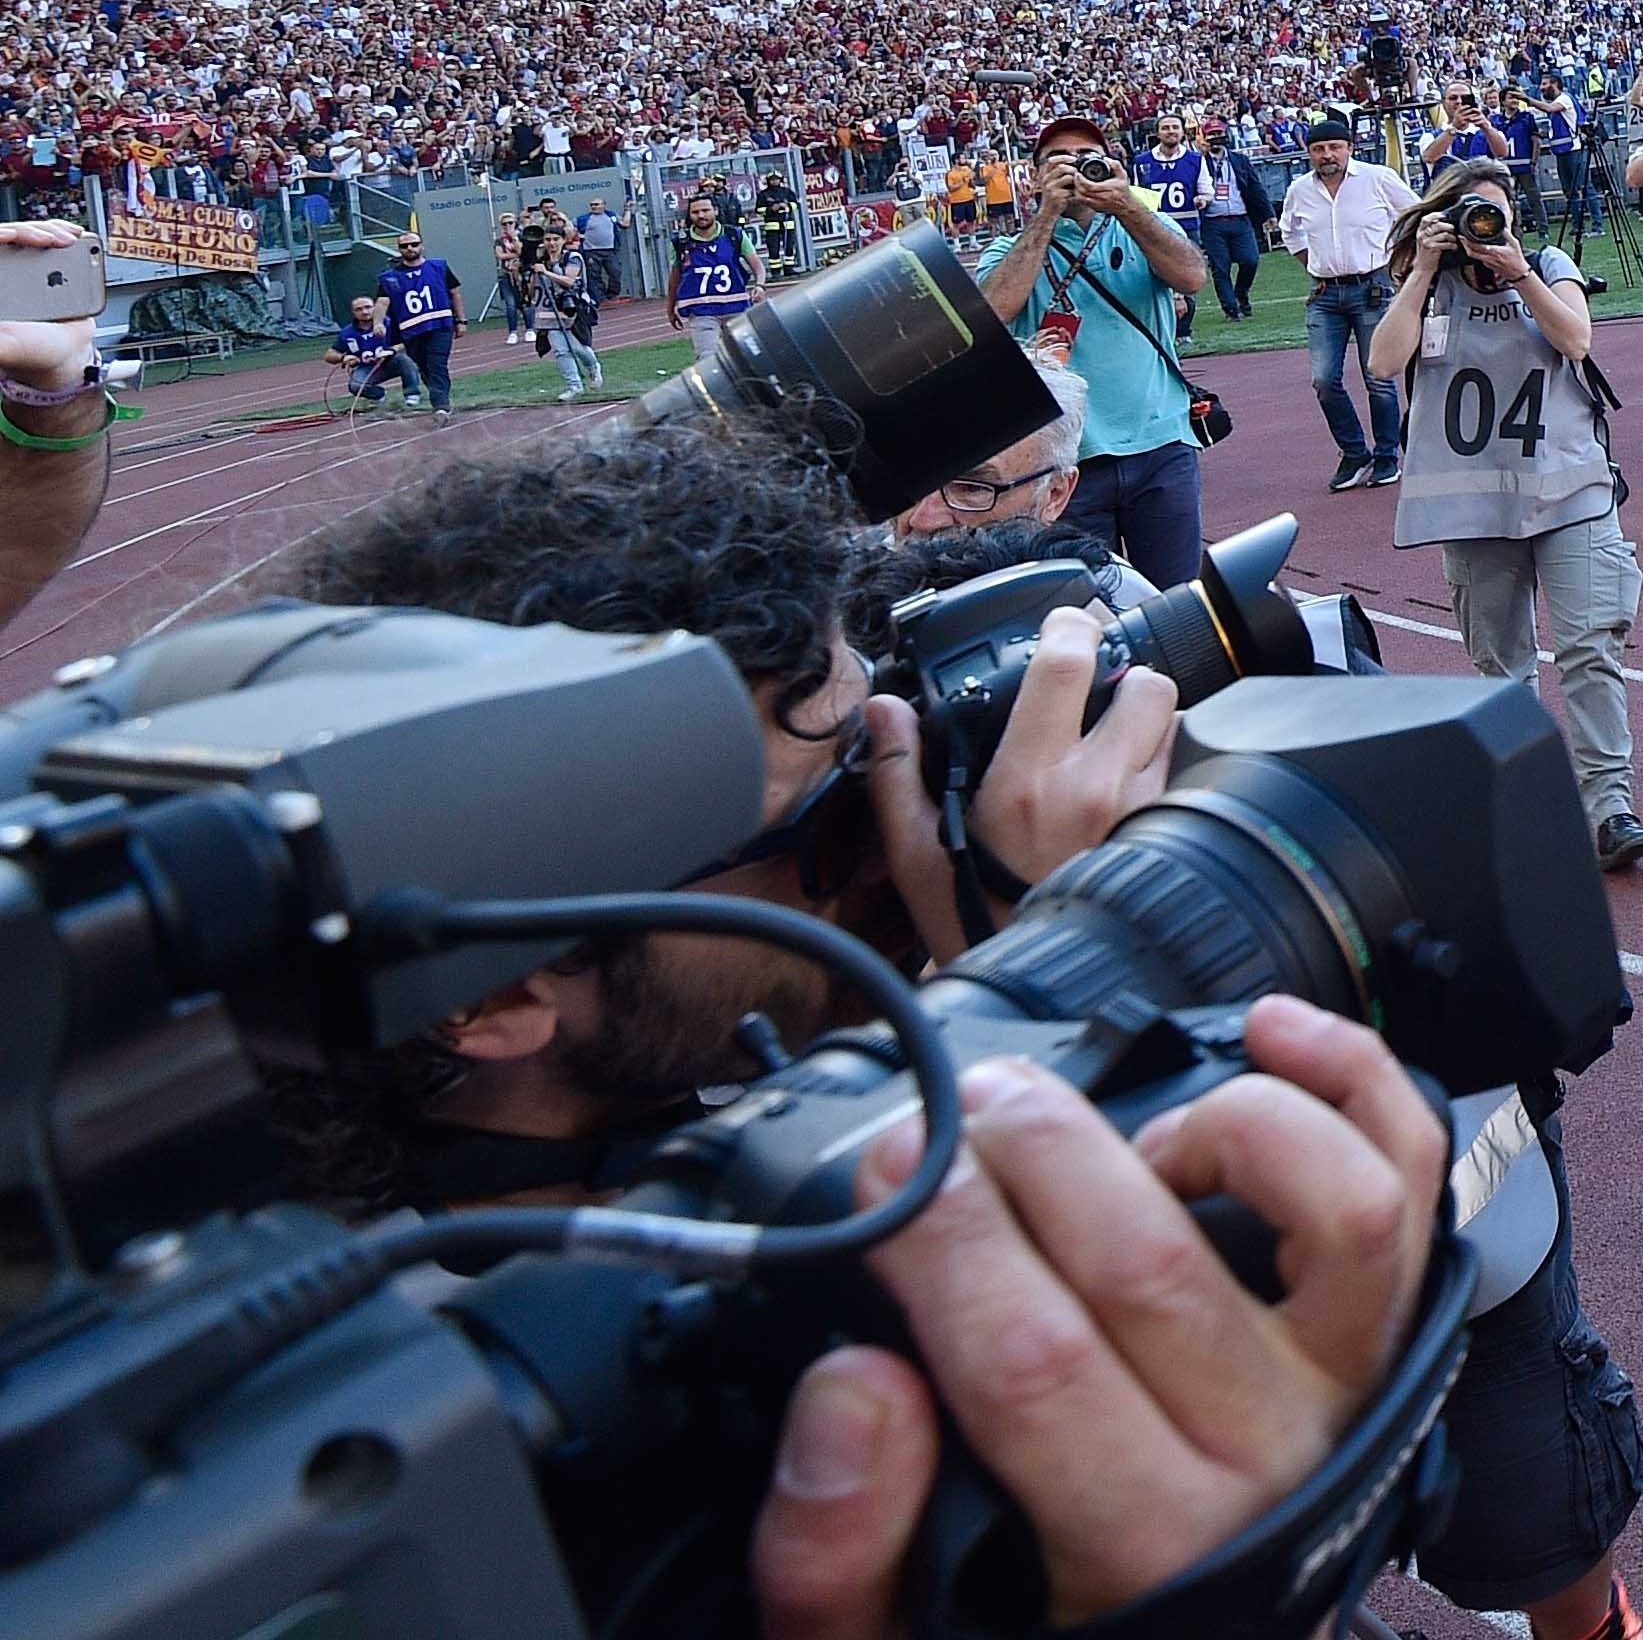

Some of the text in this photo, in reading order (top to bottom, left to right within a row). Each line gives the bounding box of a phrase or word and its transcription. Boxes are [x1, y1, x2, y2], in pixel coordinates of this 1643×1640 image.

[1161, 162, 1176, 170] TV
[533, 179, 612, 197] Stadio Olimpico
[1150, 181, 1185, 209] 76
[193, 206, 235, 228] CLUB
[430, 199, 462, 211] Stadio
[111, 214, 258, 253] NETTUNO
[116, 240, 252, 268] Daniele De Rossi
[405, 269, 422, 279] TV
[694, 264, 732, 294] 73
[405, 285, 434, 314] 61
[1445, 367, 1545, 458] 04
